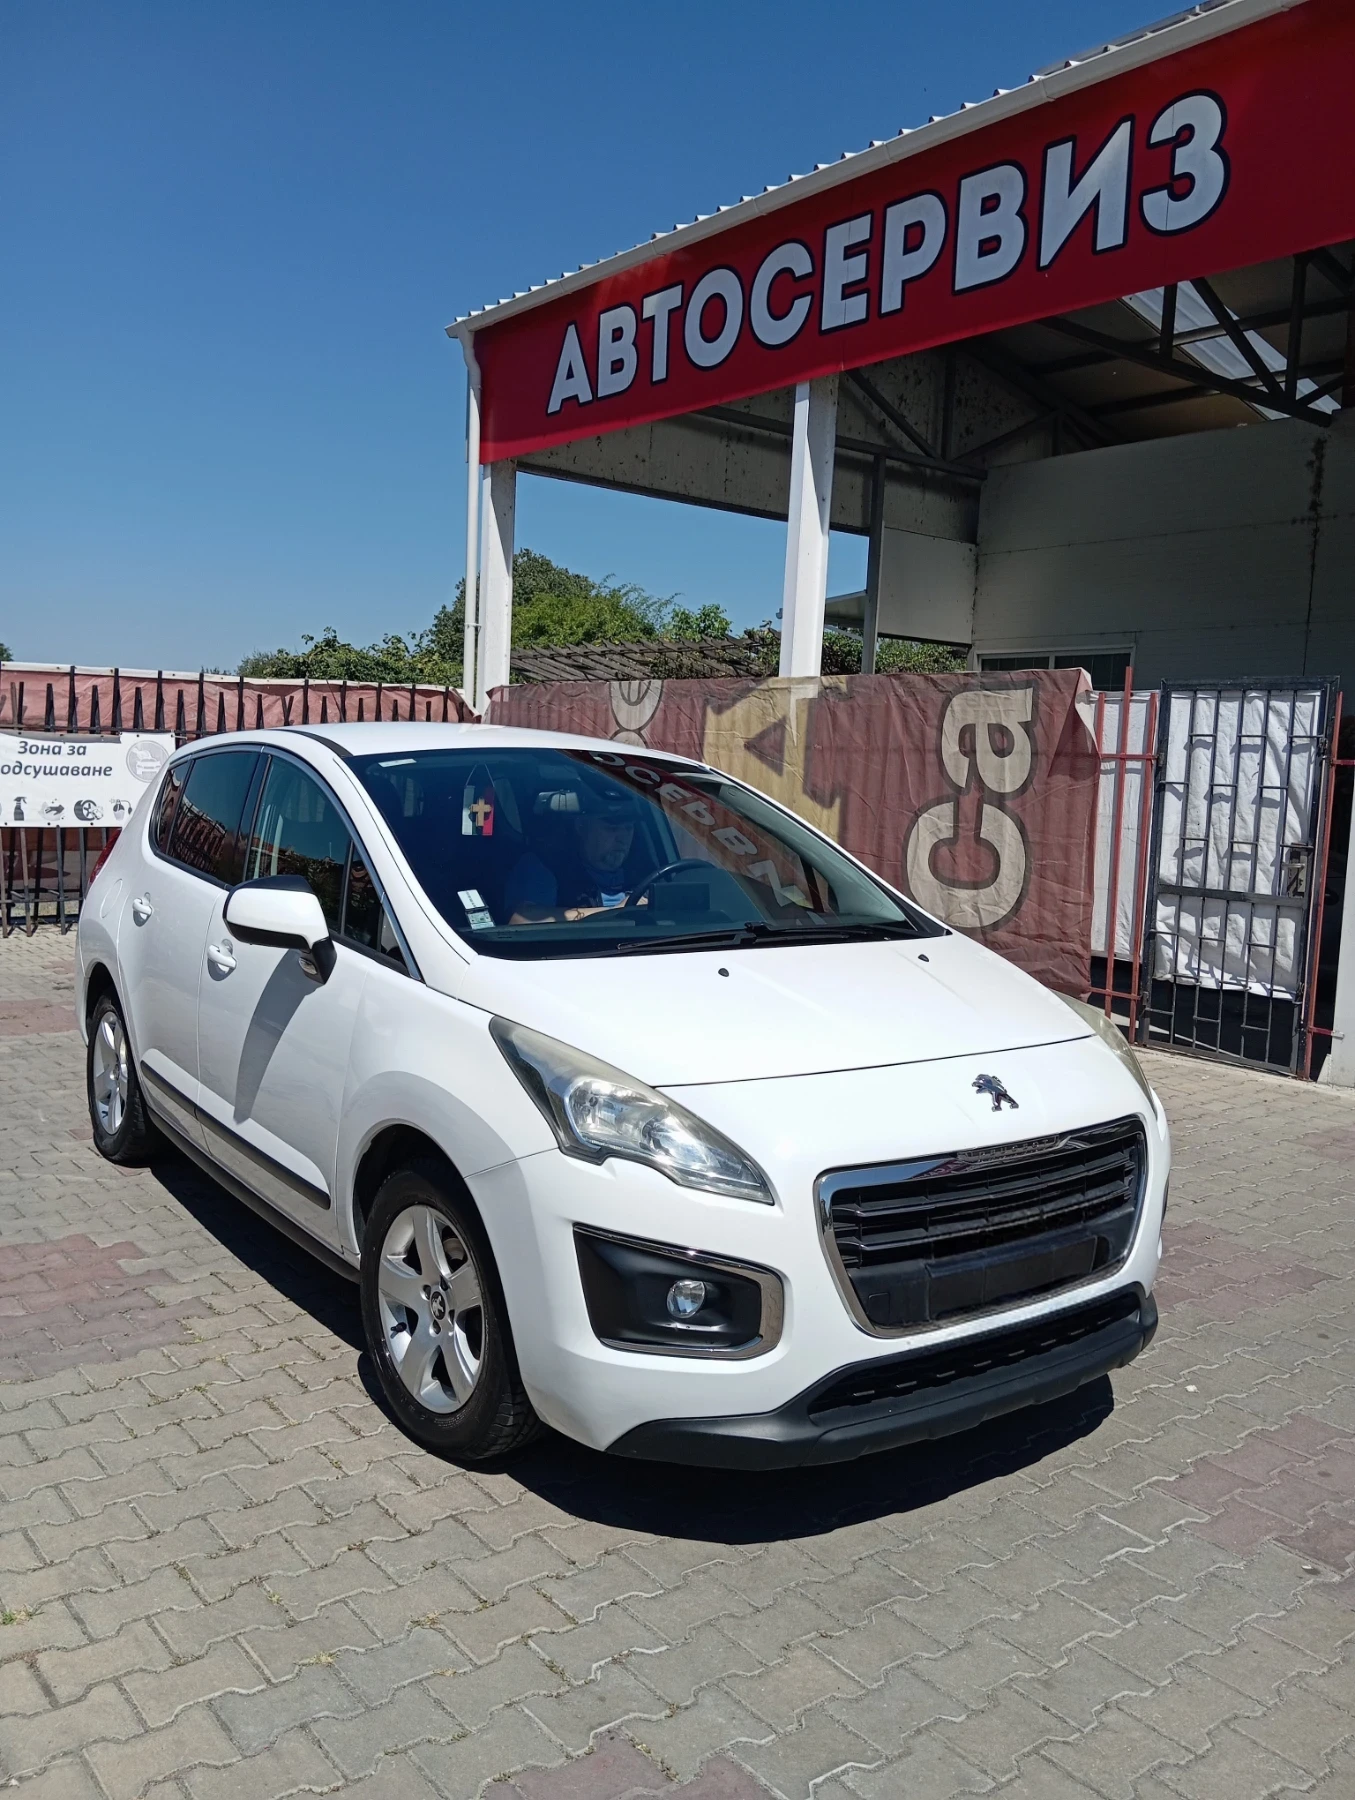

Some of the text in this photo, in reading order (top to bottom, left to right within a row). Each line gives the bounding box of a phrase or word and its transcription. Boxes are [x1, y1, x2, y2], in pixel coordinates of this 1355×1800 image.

[546, 91, 1228, 414] АВТОСЕРВИЗ
[18, 740, 87, 756] Зона за
[0, 760, 113, 779] одсушаване
